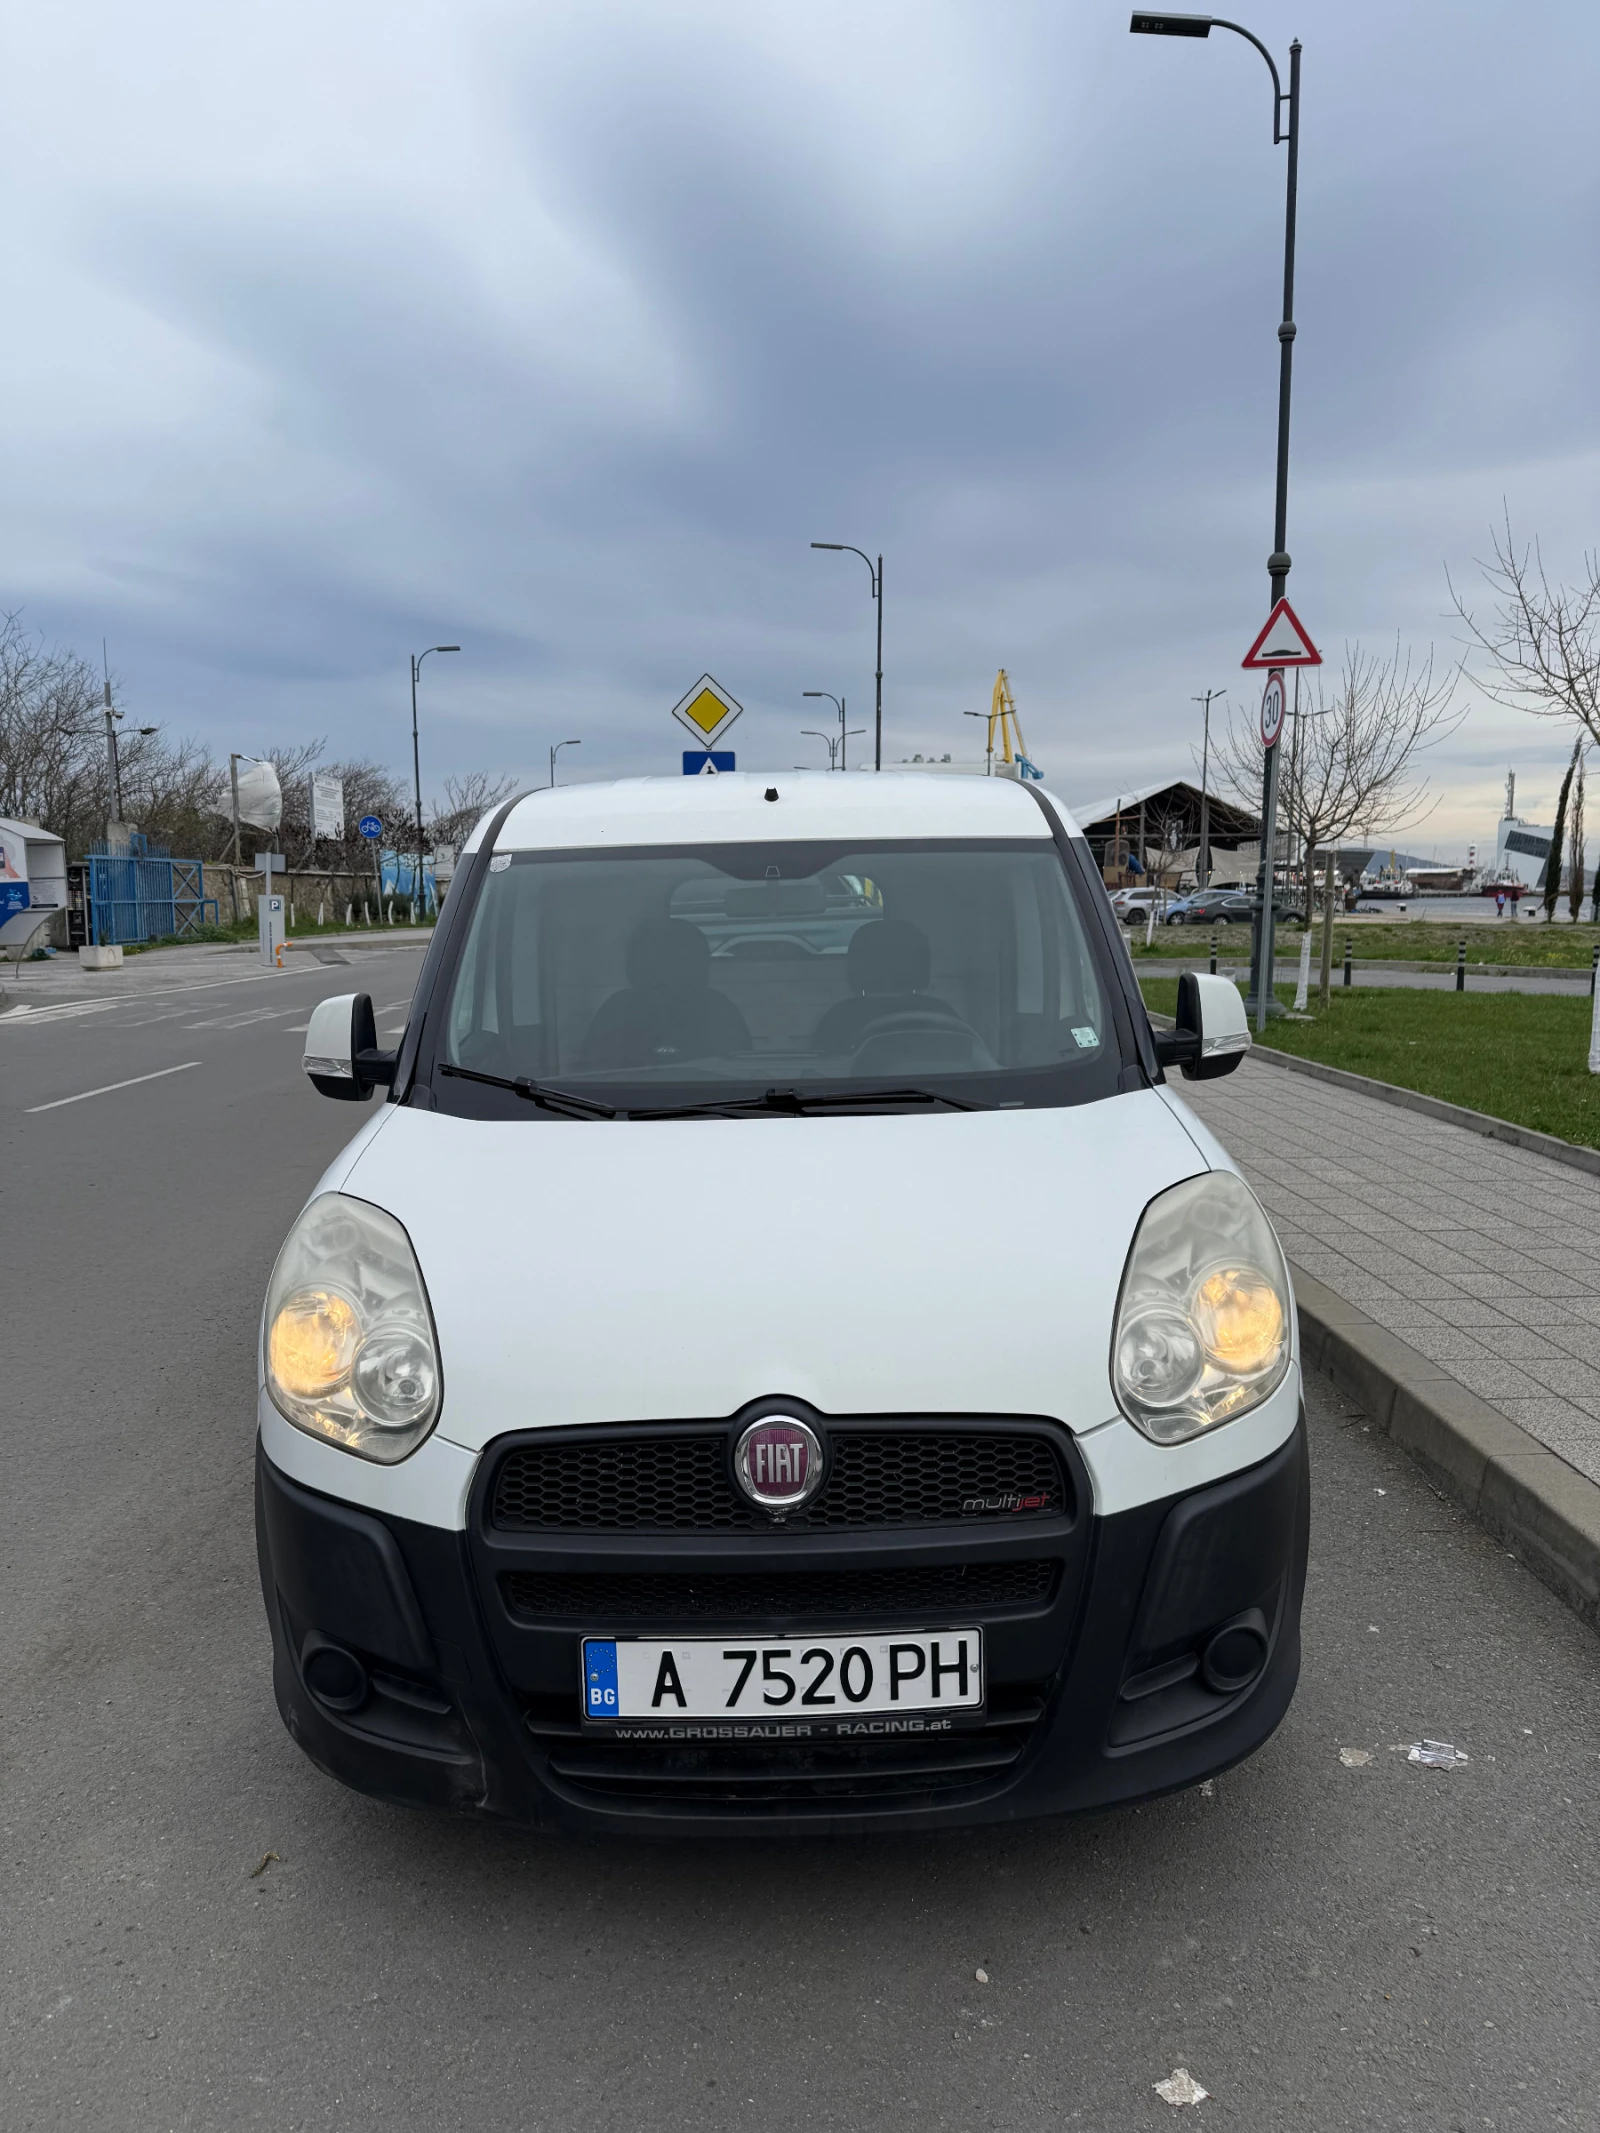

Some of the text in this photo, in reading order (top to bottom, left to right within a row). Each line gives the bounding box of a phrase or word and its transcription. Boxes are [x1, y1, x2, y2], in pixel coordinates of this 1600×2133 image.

[1265, 690, 1279, 729] 30
[271, 901, 279, 910] P
[756, 1443, 804, 1484] FIAT
[963, 1492, 1050, 1512] multijet
[651, 1640, 969, 1707] A 7520 PH
[590, 1688, 616, 1706] BG
[615, 1725, 812, 1739] www.GROSSAUER
[836, 1719, 952, 1735] RACING.at
